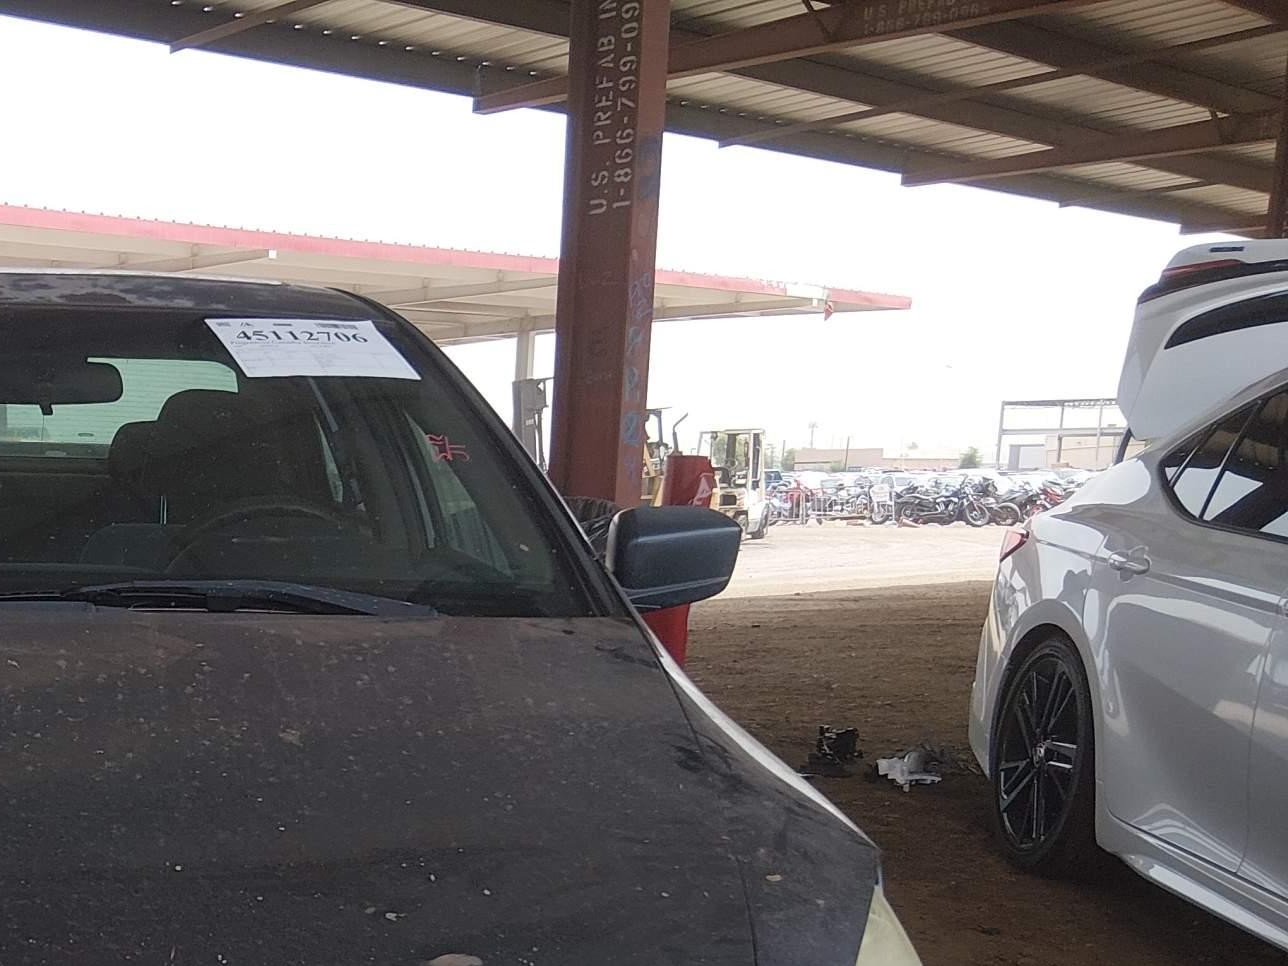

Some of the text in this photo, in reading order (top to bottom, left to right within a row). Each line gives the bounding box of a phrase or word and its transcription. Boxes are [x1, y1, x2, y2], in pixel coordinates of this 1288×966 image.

[593, 35, 615, 145] PREFAB
[588, 160, 610, 215] U.S.
[236, 330, 368, 343] 45112706
